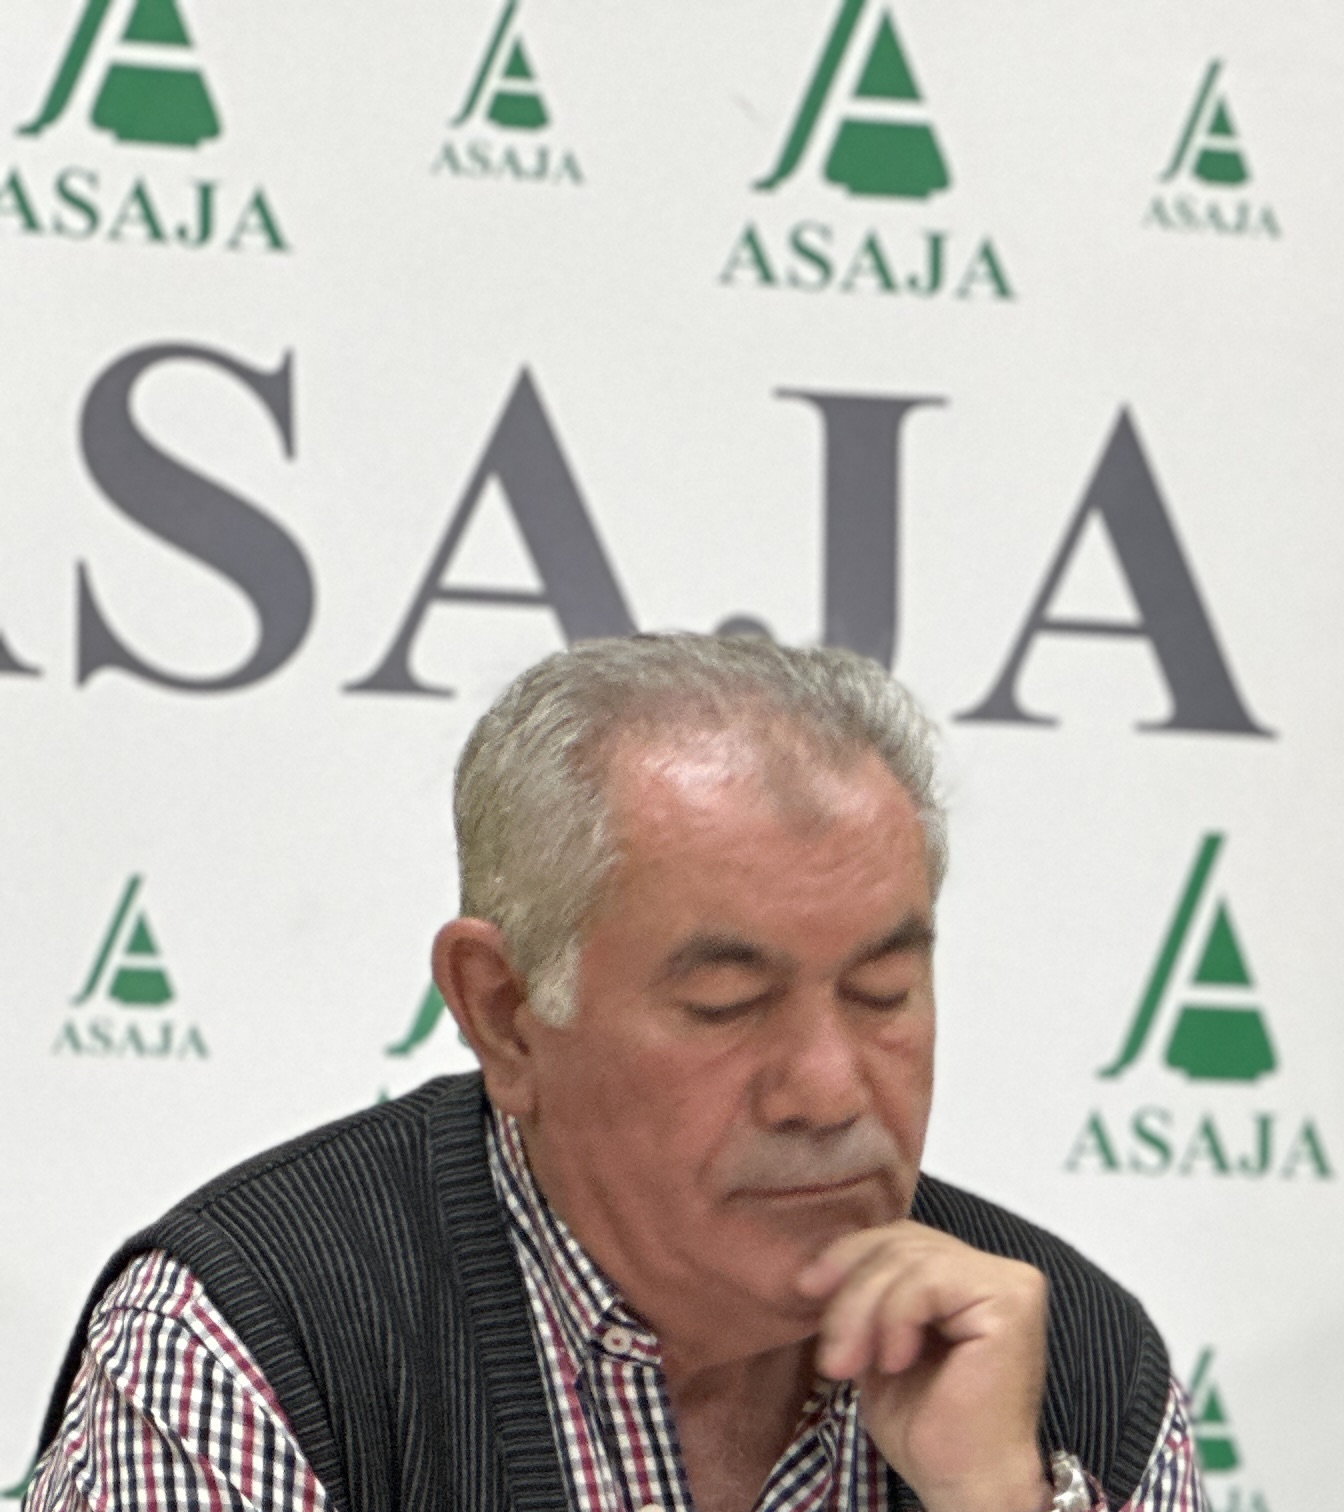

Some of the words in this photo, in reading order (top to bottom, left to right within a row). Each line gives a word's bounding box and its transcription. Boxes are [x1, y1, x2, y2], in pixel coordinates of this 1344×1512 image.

[431, 140, 586, 186] ASAJA
[0, 166, 292, 254] ASAJA
[1145, 197, 1282, 240] ASAJA
[718, 221, 1017, 302] ASAJA
[0, 342, 1278, 740] SAJA
[53, 1020, 210, 1060] ASAJA
[1065, 1108, 1336, 1182] ASAJA
